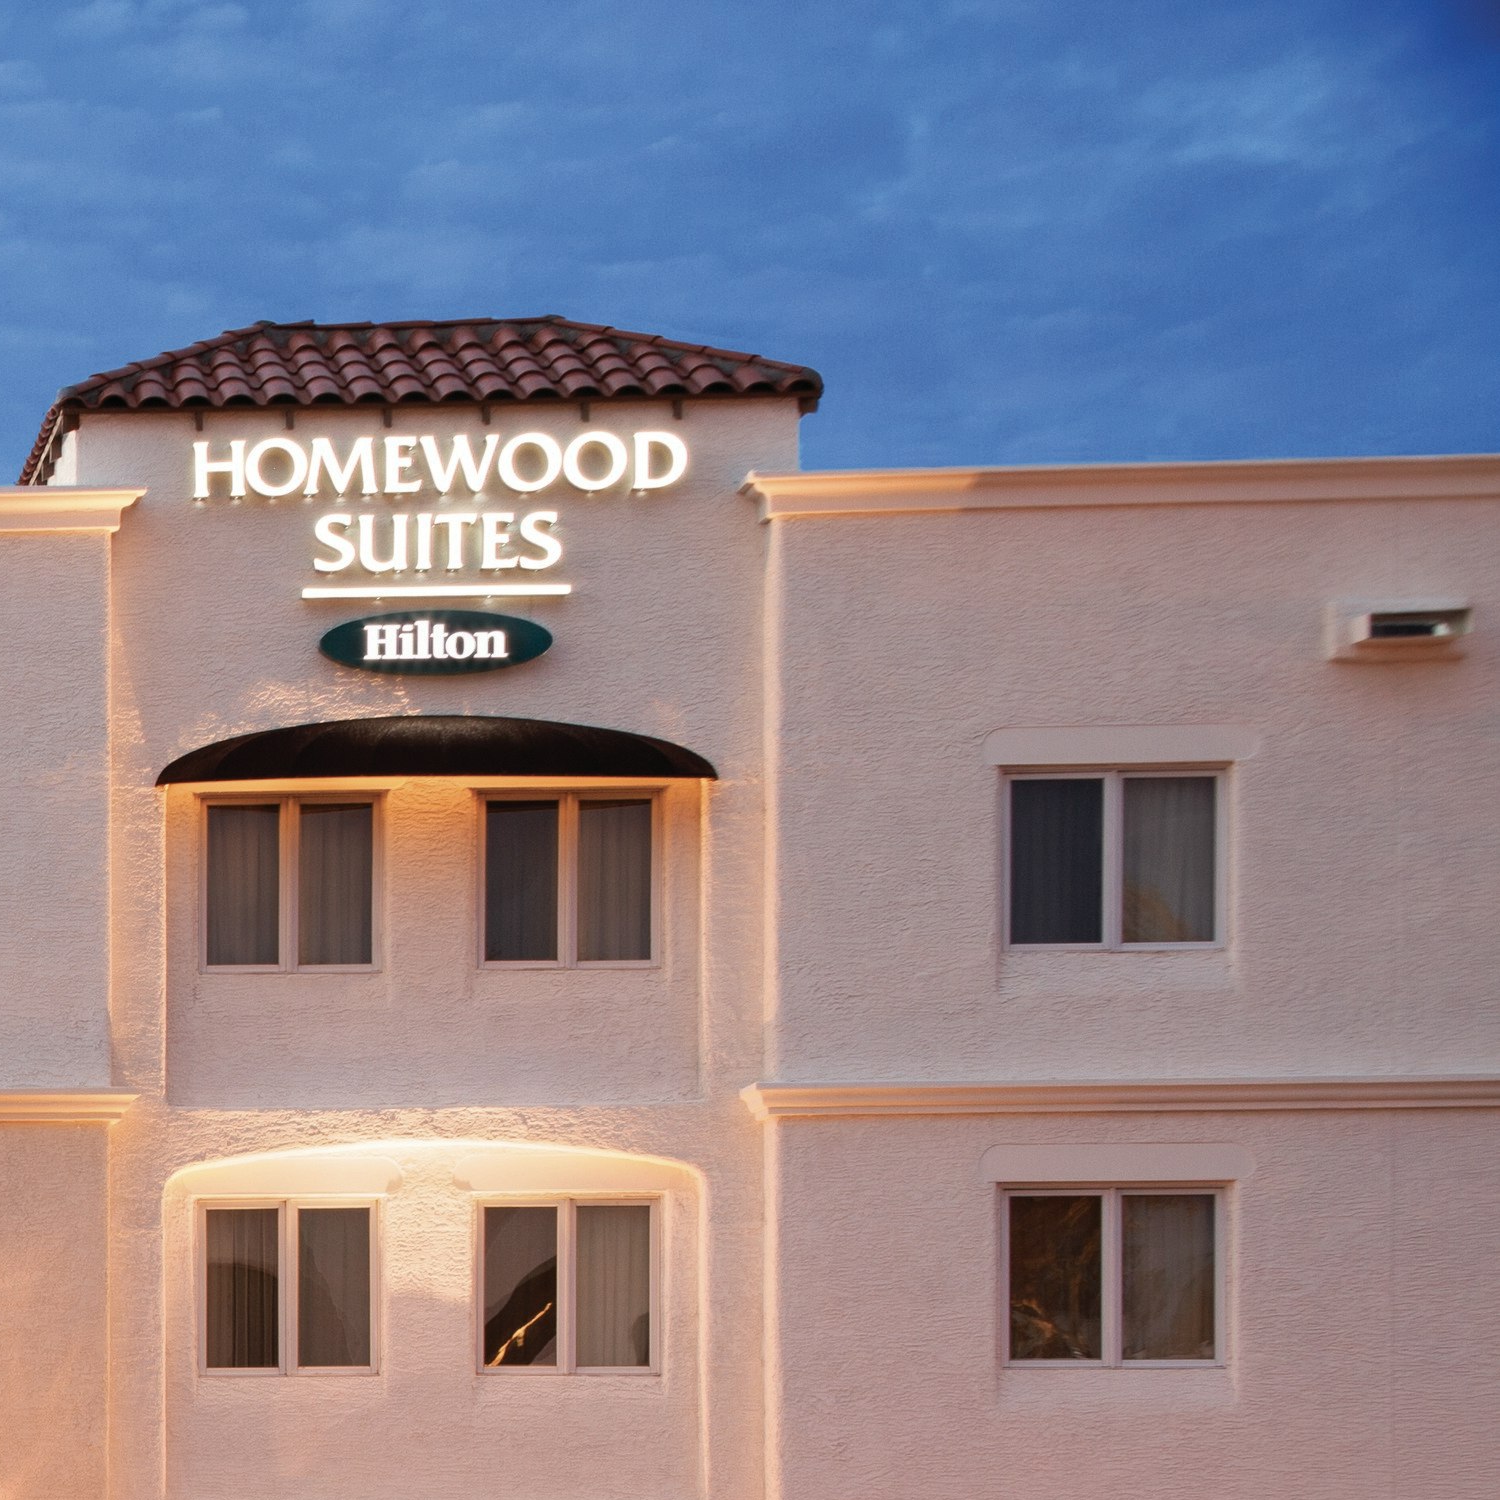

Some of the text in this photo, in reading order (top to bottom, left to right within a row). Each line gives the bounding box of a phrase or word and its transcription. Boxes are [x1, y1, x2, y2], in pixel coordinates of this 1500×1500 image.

[192, 431, 689, 499] HOMEWOOD
[312, 510, 565, 573] SUITES
[363, 620, 510, 662] Hilton
